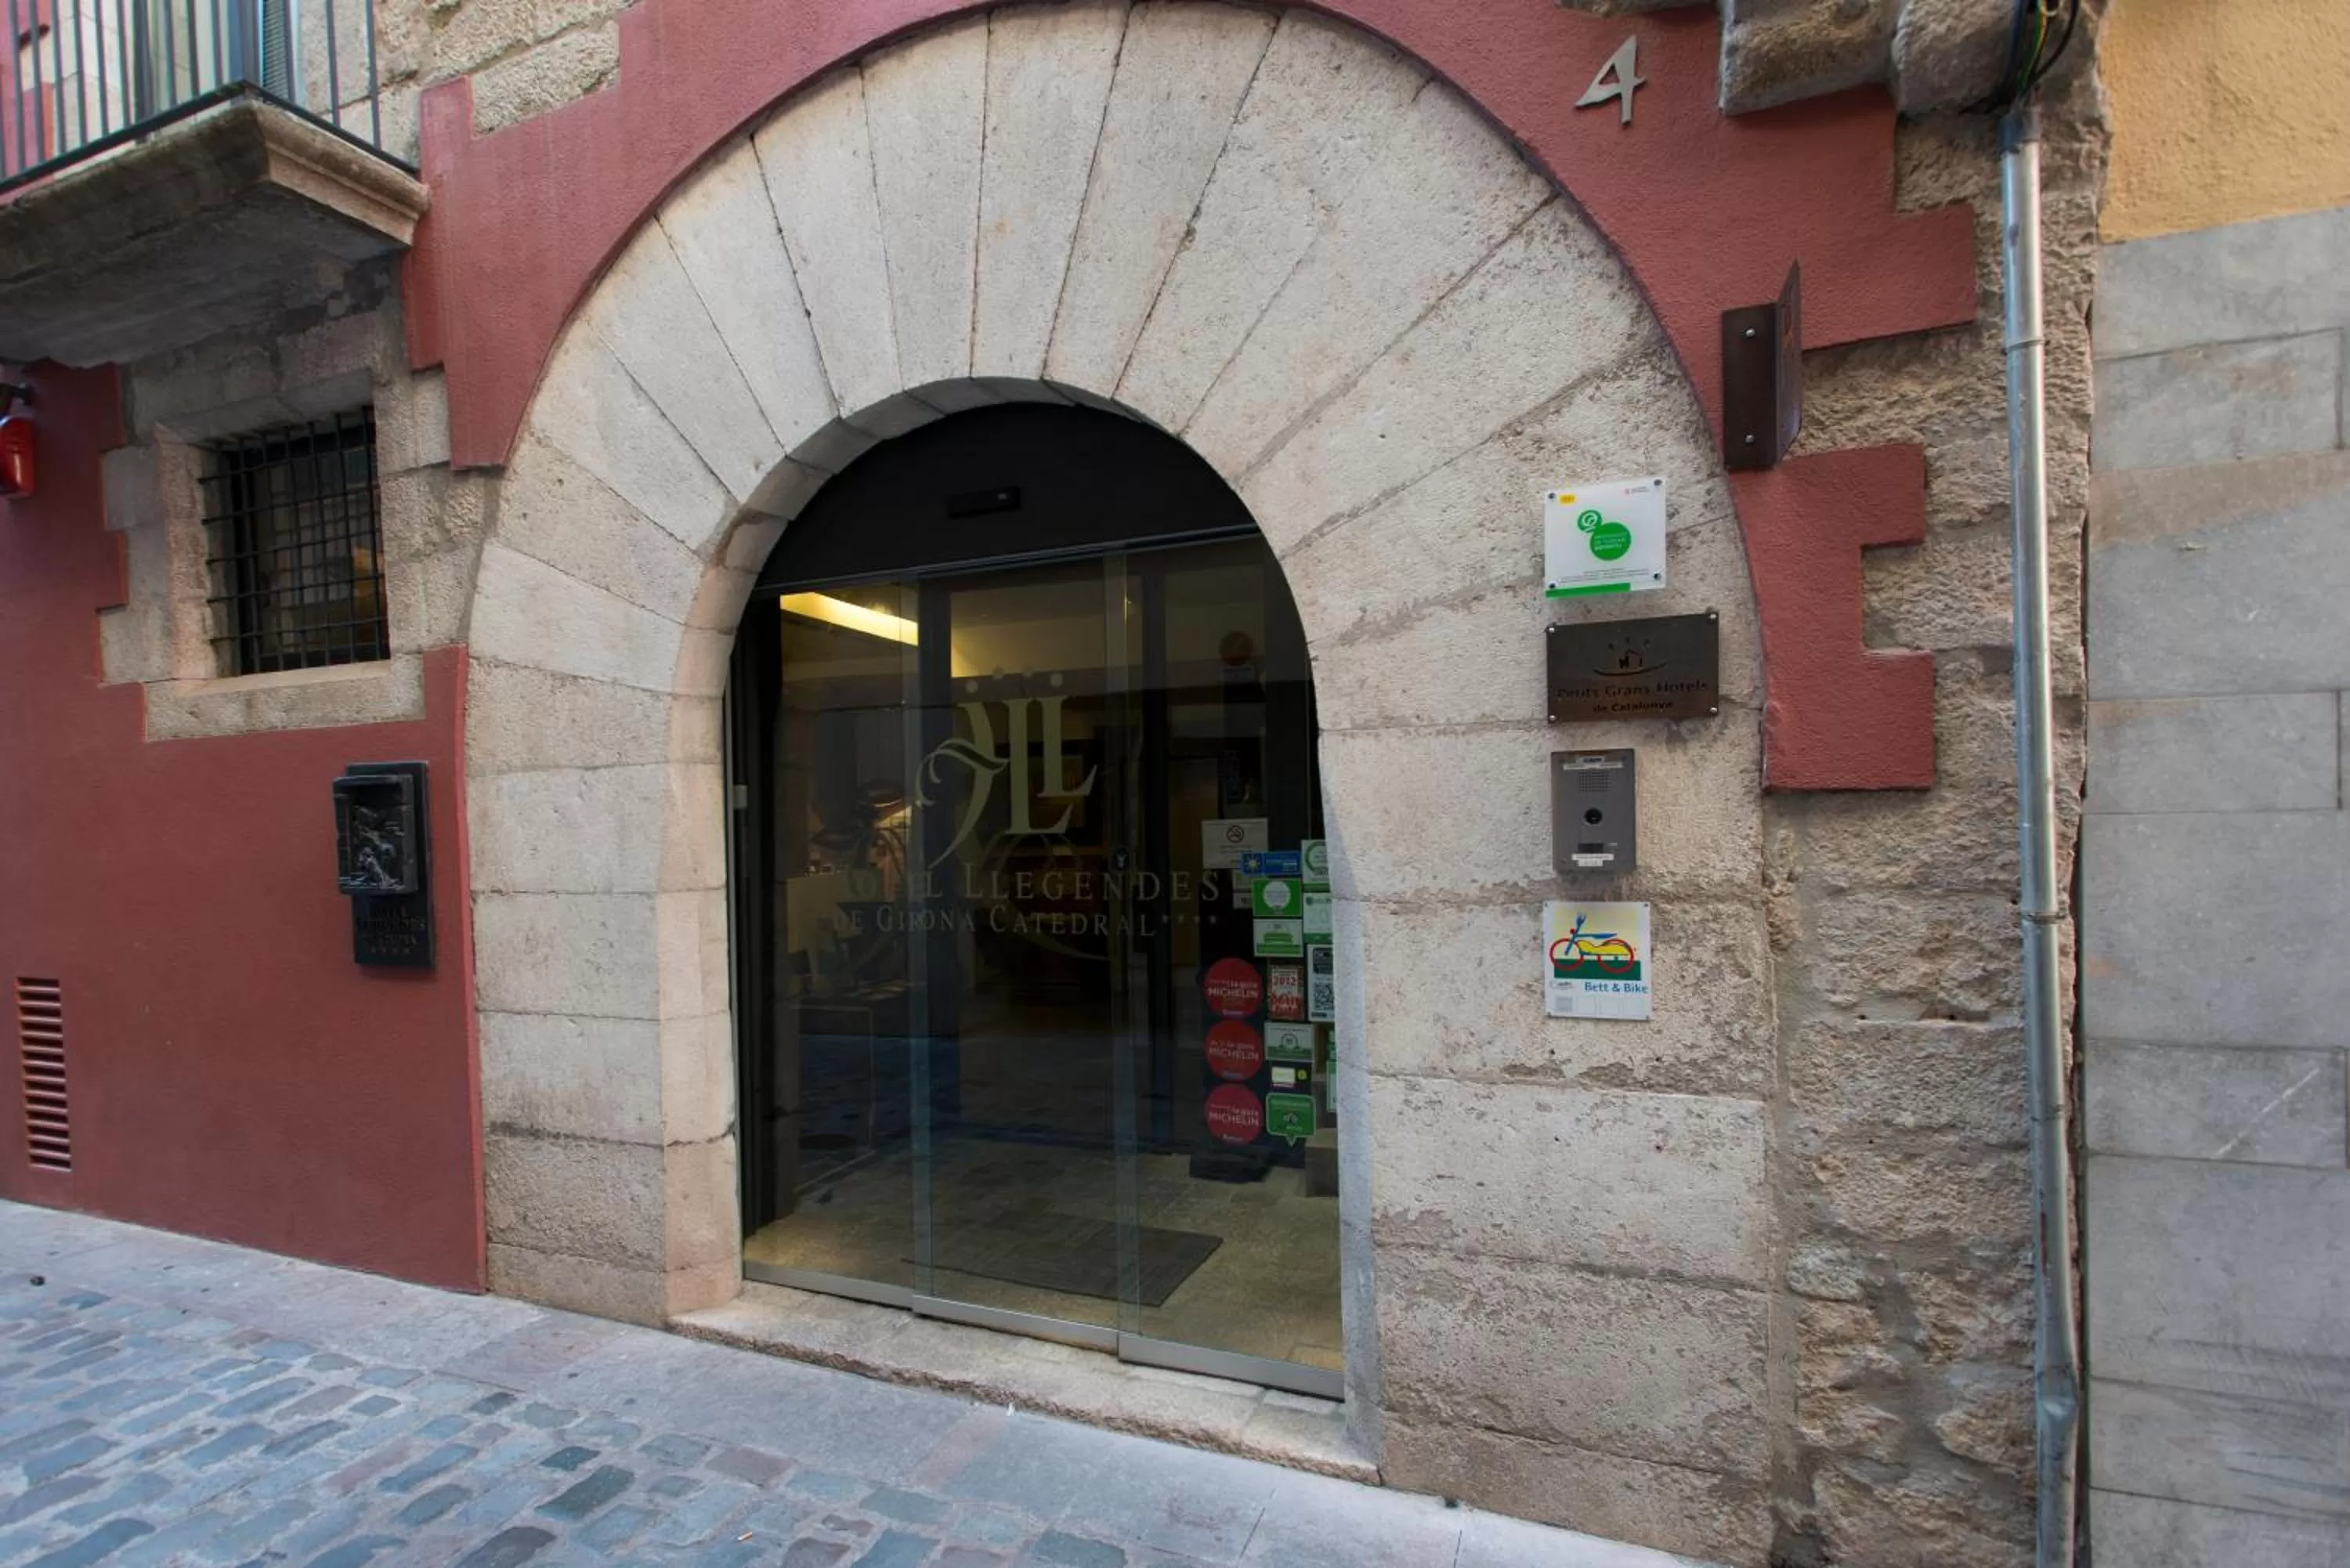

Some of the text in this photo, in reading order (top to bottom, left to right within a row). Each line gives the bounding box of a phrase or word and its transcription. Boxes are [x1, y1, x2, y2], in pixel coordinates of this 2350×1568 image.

[1574, 35, 1647, 125] 4
[1593, 703, 1607, 713] de
[964, 864, 1220, 902] LLEGENDES
[877, 904, 977, 934] GIRONA
[989, 905, 1157, 938] CATEDRAL
[1208, 986, 1258, 999] MICHELIN
[1585, 981, 1609, 992] Bett
[1612, 983, 1620, 992] &
[1625, 983, 1648, 994] Bike
[1209, 1046, 1259, 1061] MICHELIN
[1209, 1111, 1260, 1127] MICHELIN
